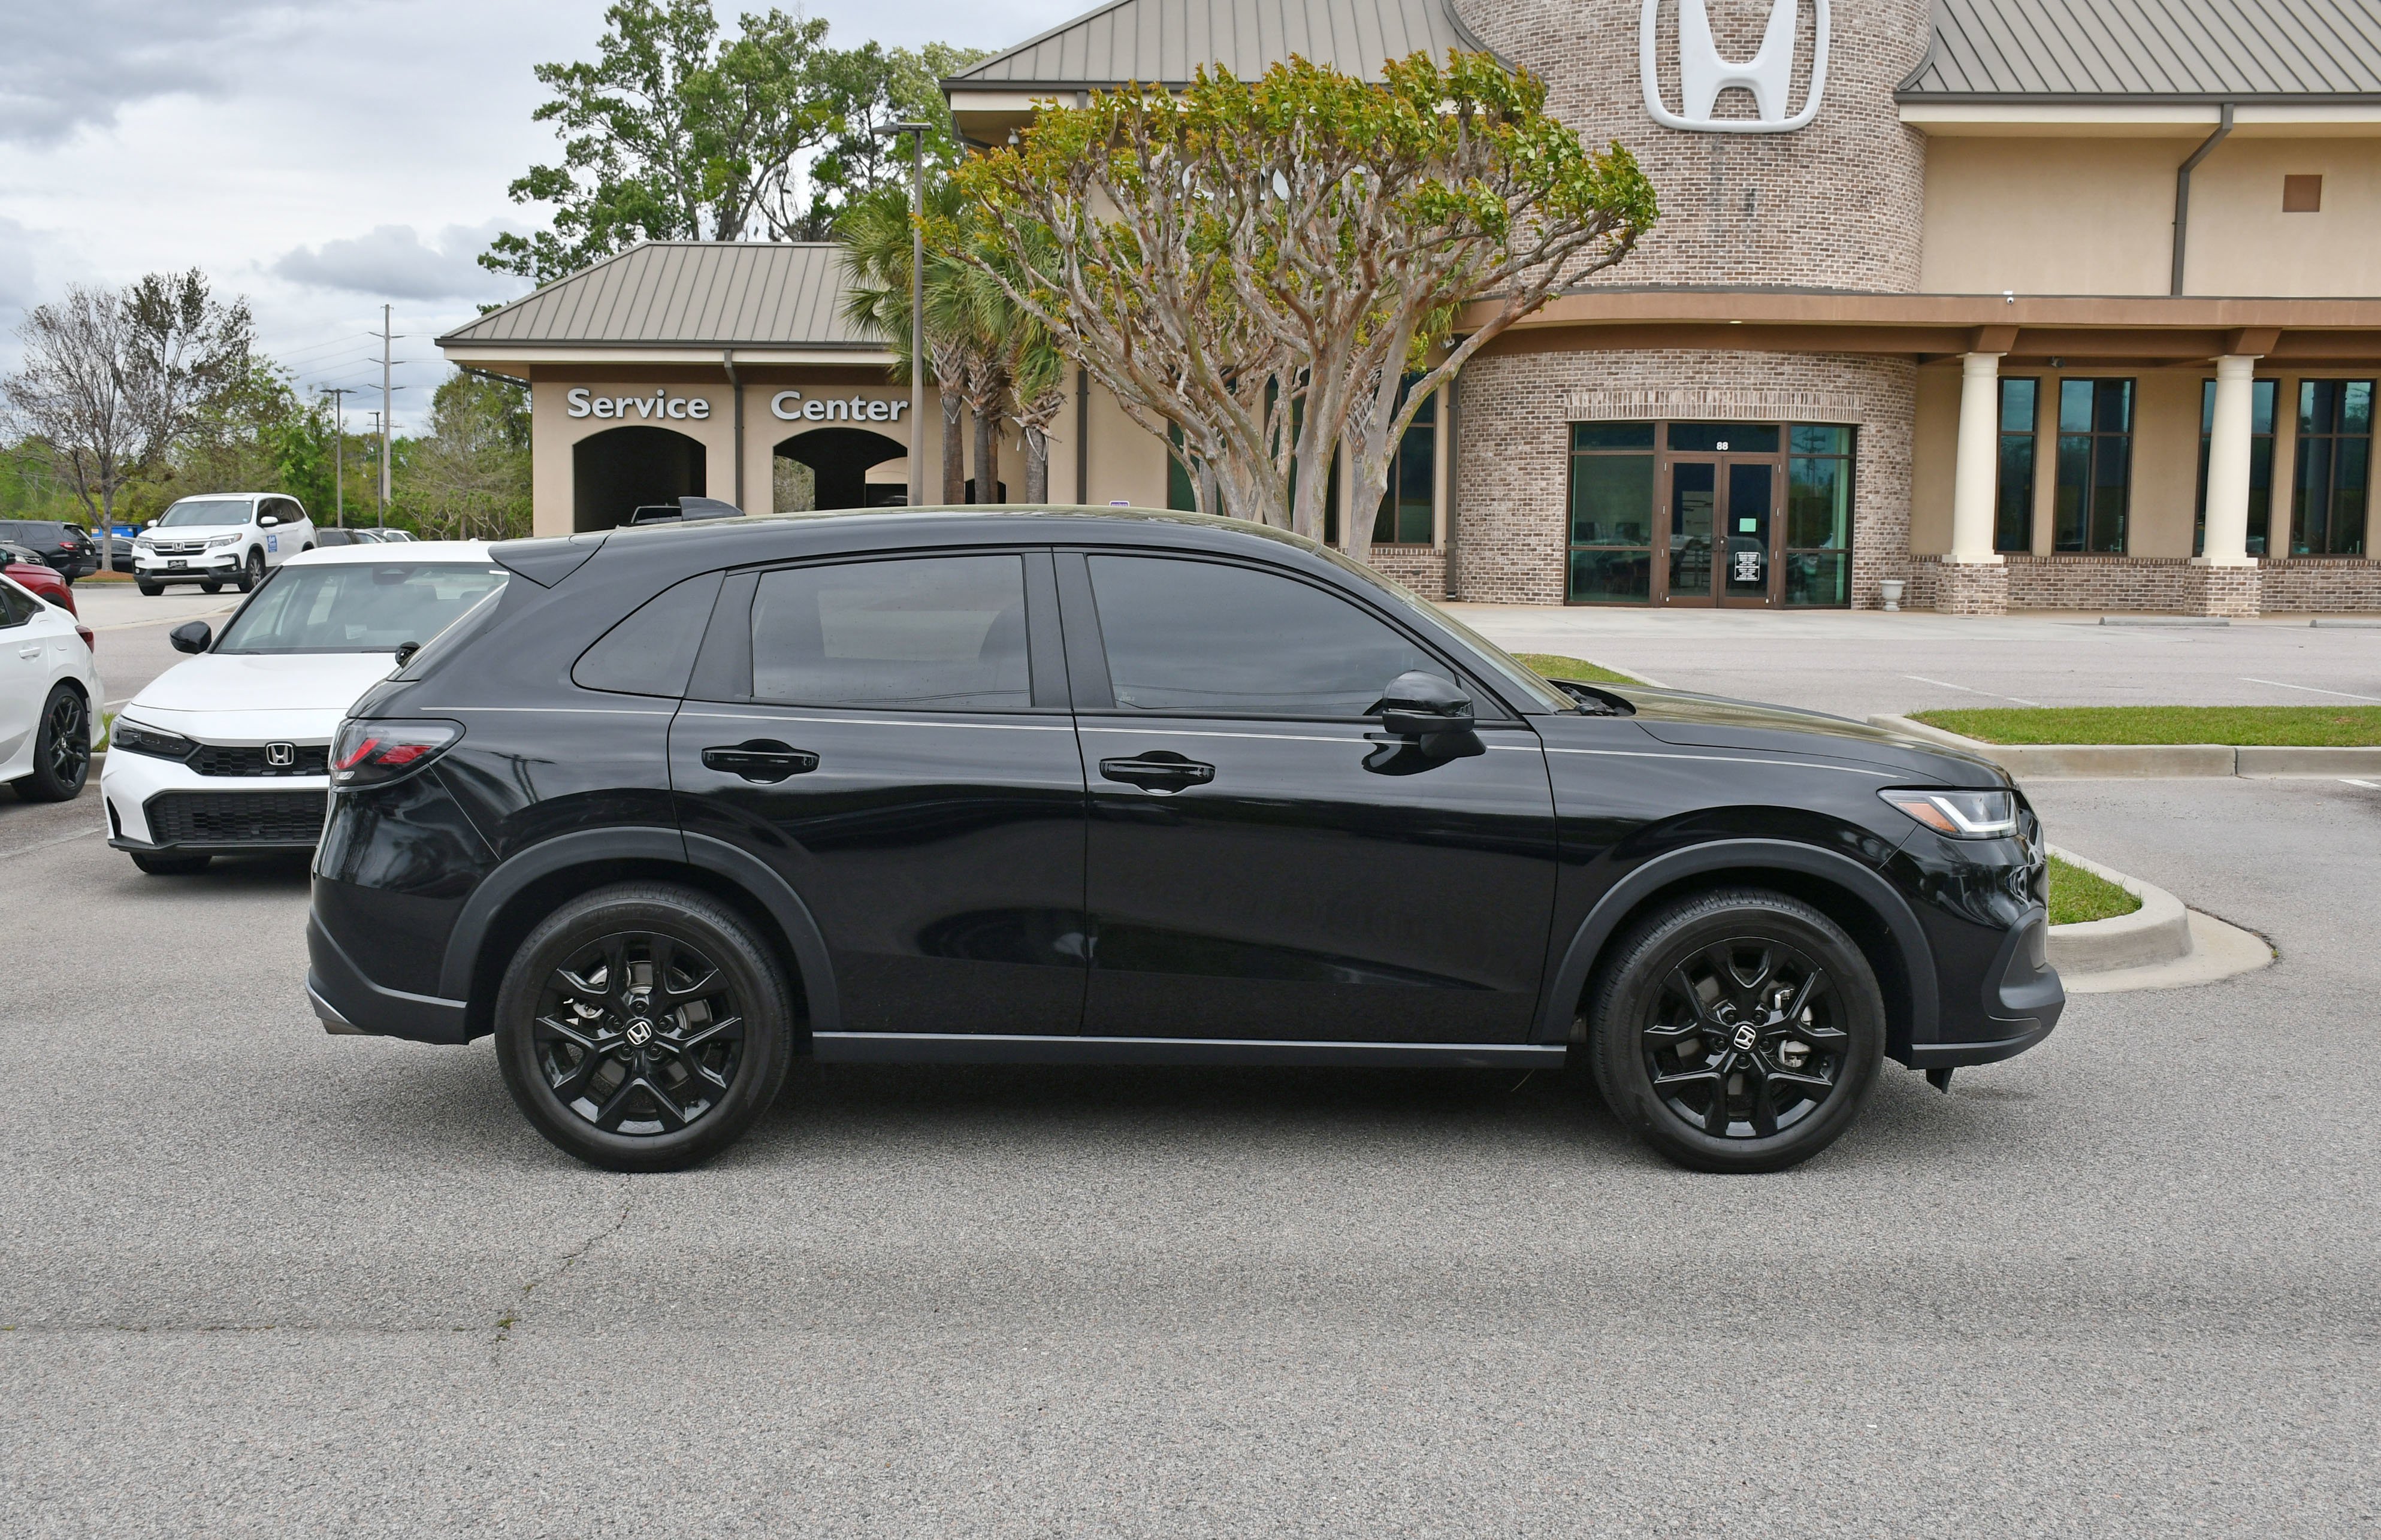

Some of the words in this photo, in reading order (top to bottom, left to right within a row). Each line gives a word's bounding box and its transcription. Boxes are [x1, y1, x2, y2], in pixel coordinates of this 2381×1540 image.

[567, 388, 709, 419] Service
[770, 391, 909, 420] Center
[1717, 441, 1729, 450] 88
